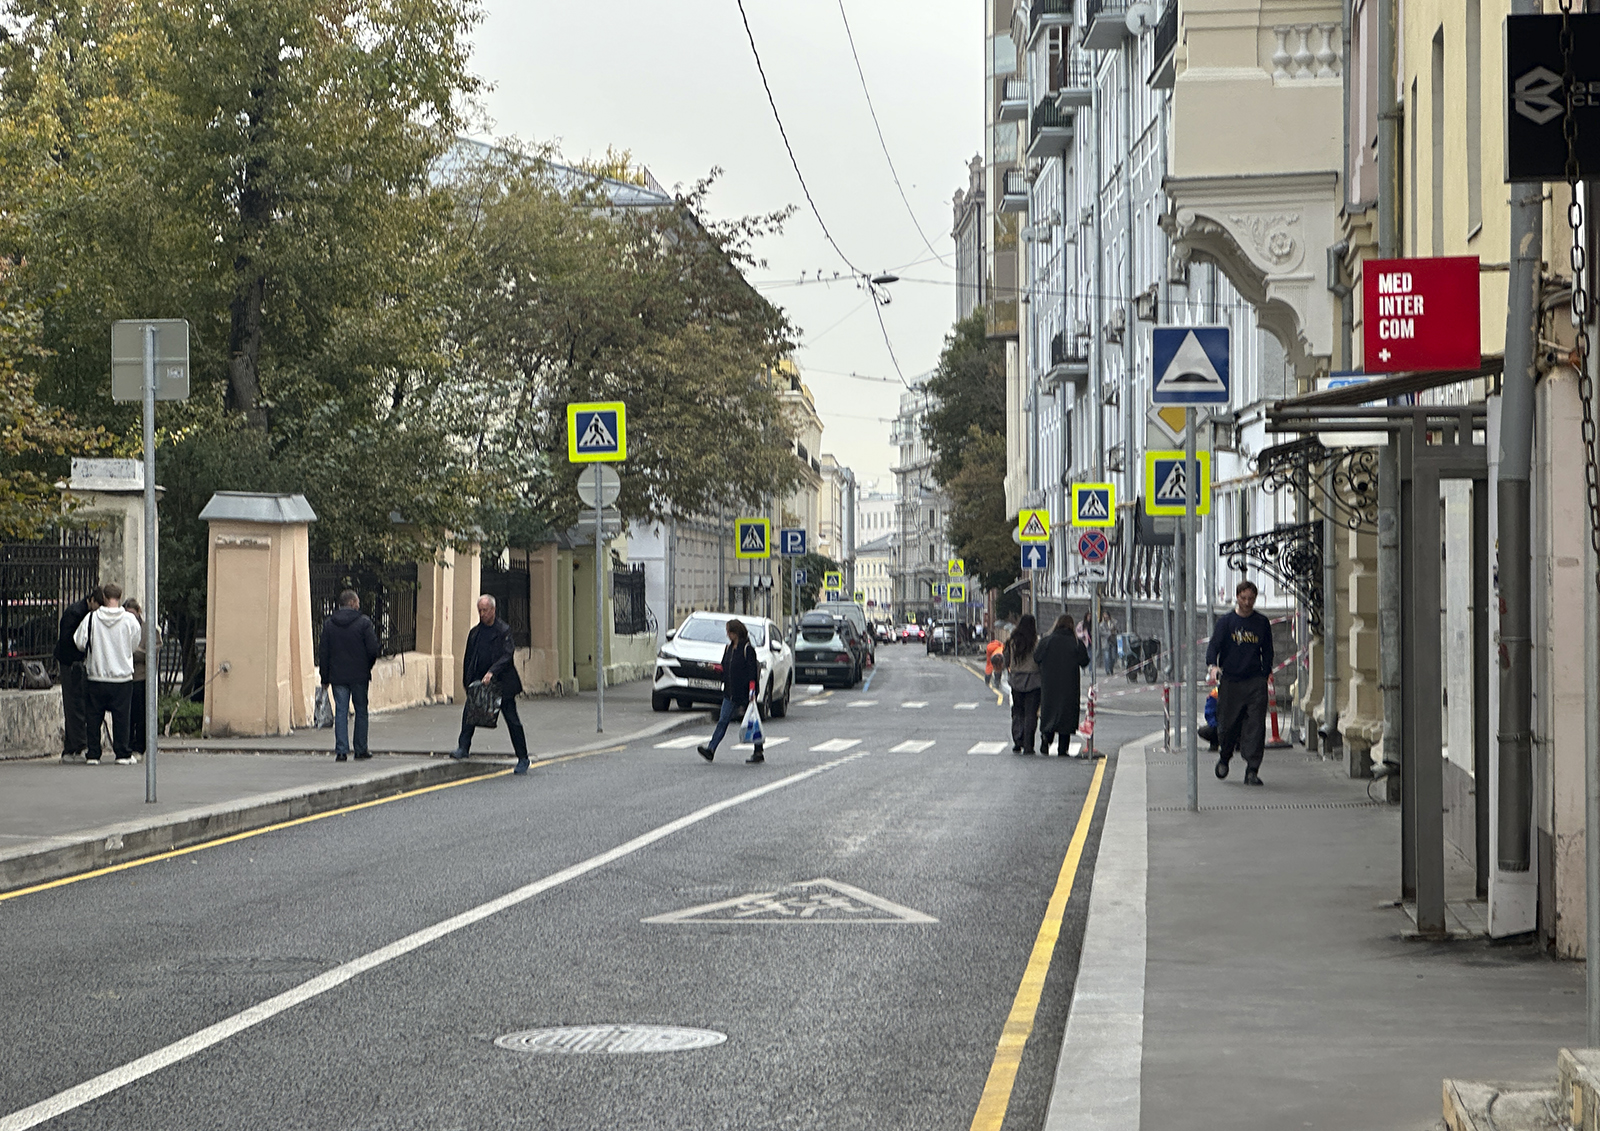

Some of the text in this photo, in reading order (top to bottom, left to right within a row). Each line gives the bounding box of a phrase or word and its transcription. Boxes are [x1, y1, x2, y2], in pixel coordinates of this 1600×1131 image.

[1378, 272, 1413, 294] MED
[1379, 294, 1425, 317] INTER
[1379, 318, 1415, 340] COM
[787, 531, 802, 553] P
